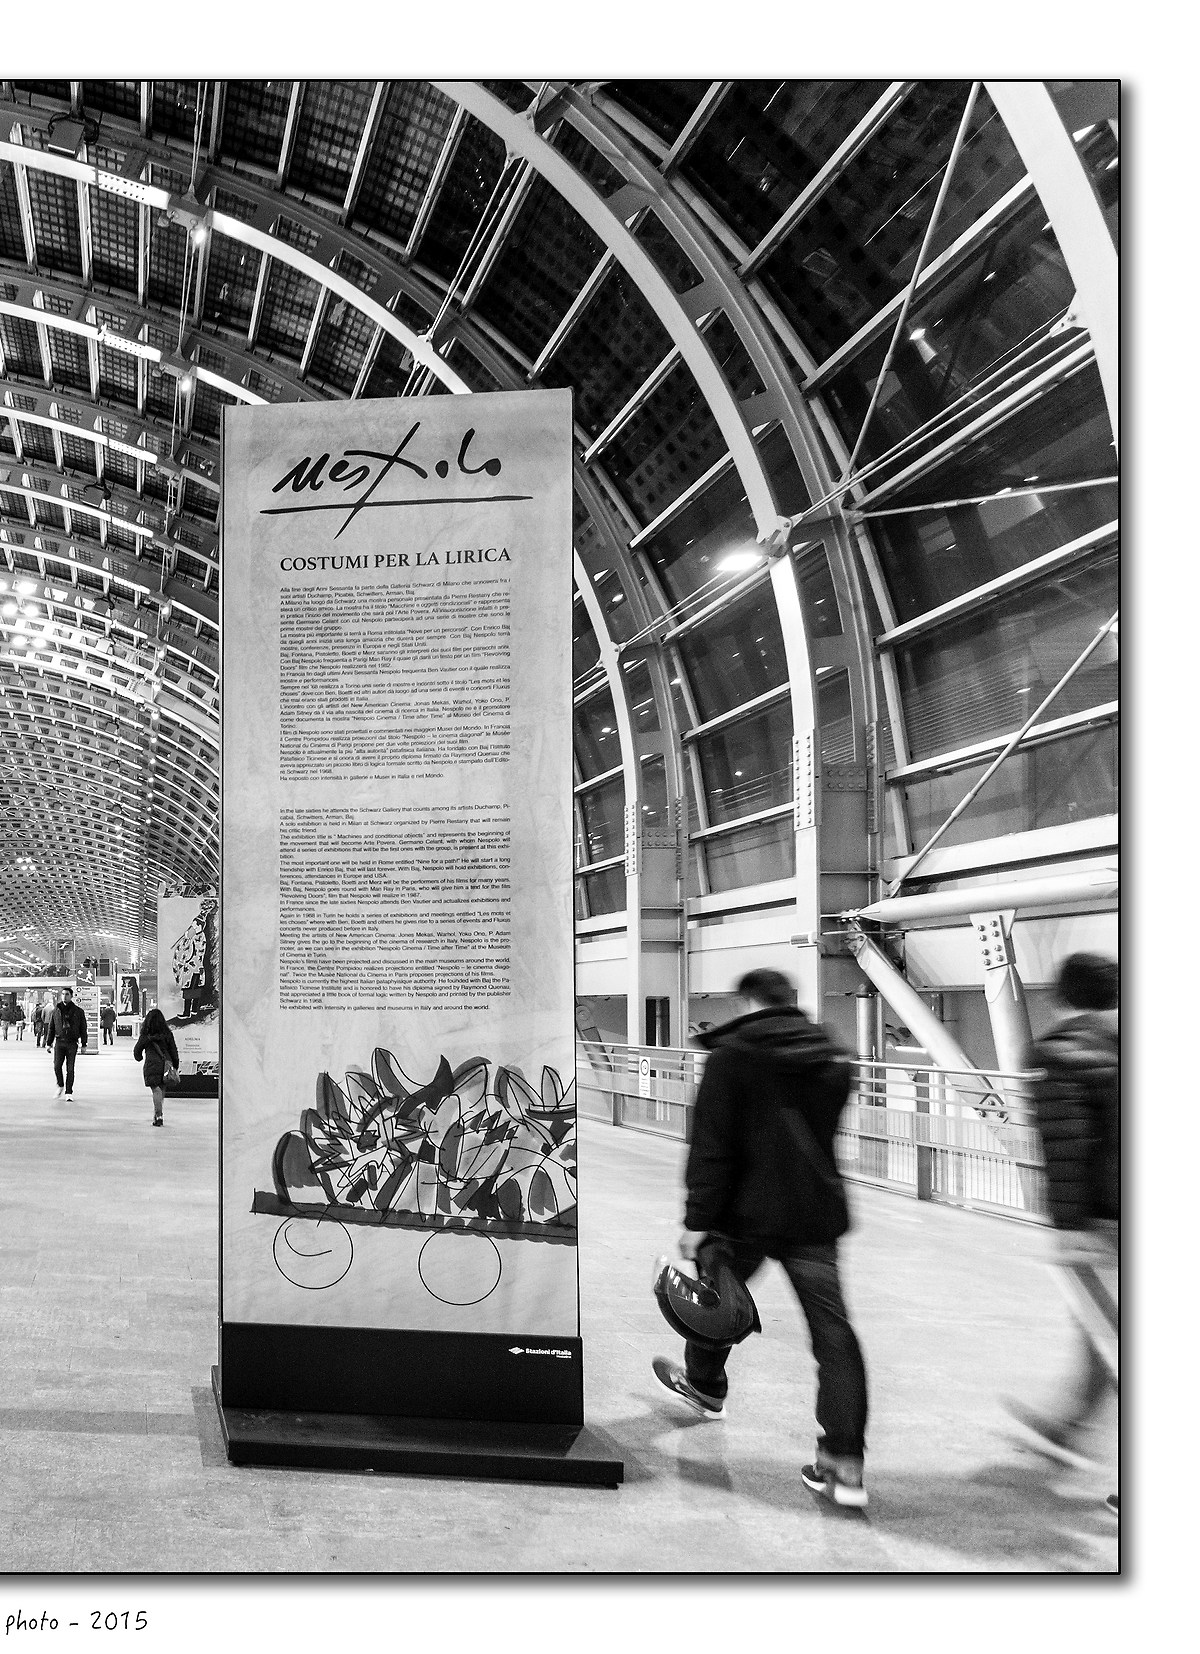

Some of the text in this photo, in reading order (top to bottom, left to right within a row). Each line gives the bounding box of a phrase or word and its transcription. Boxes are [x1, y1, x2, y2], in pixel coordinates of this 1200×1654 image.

[280, 547, 511, 572] COSTUMI PER LA LIRICA
